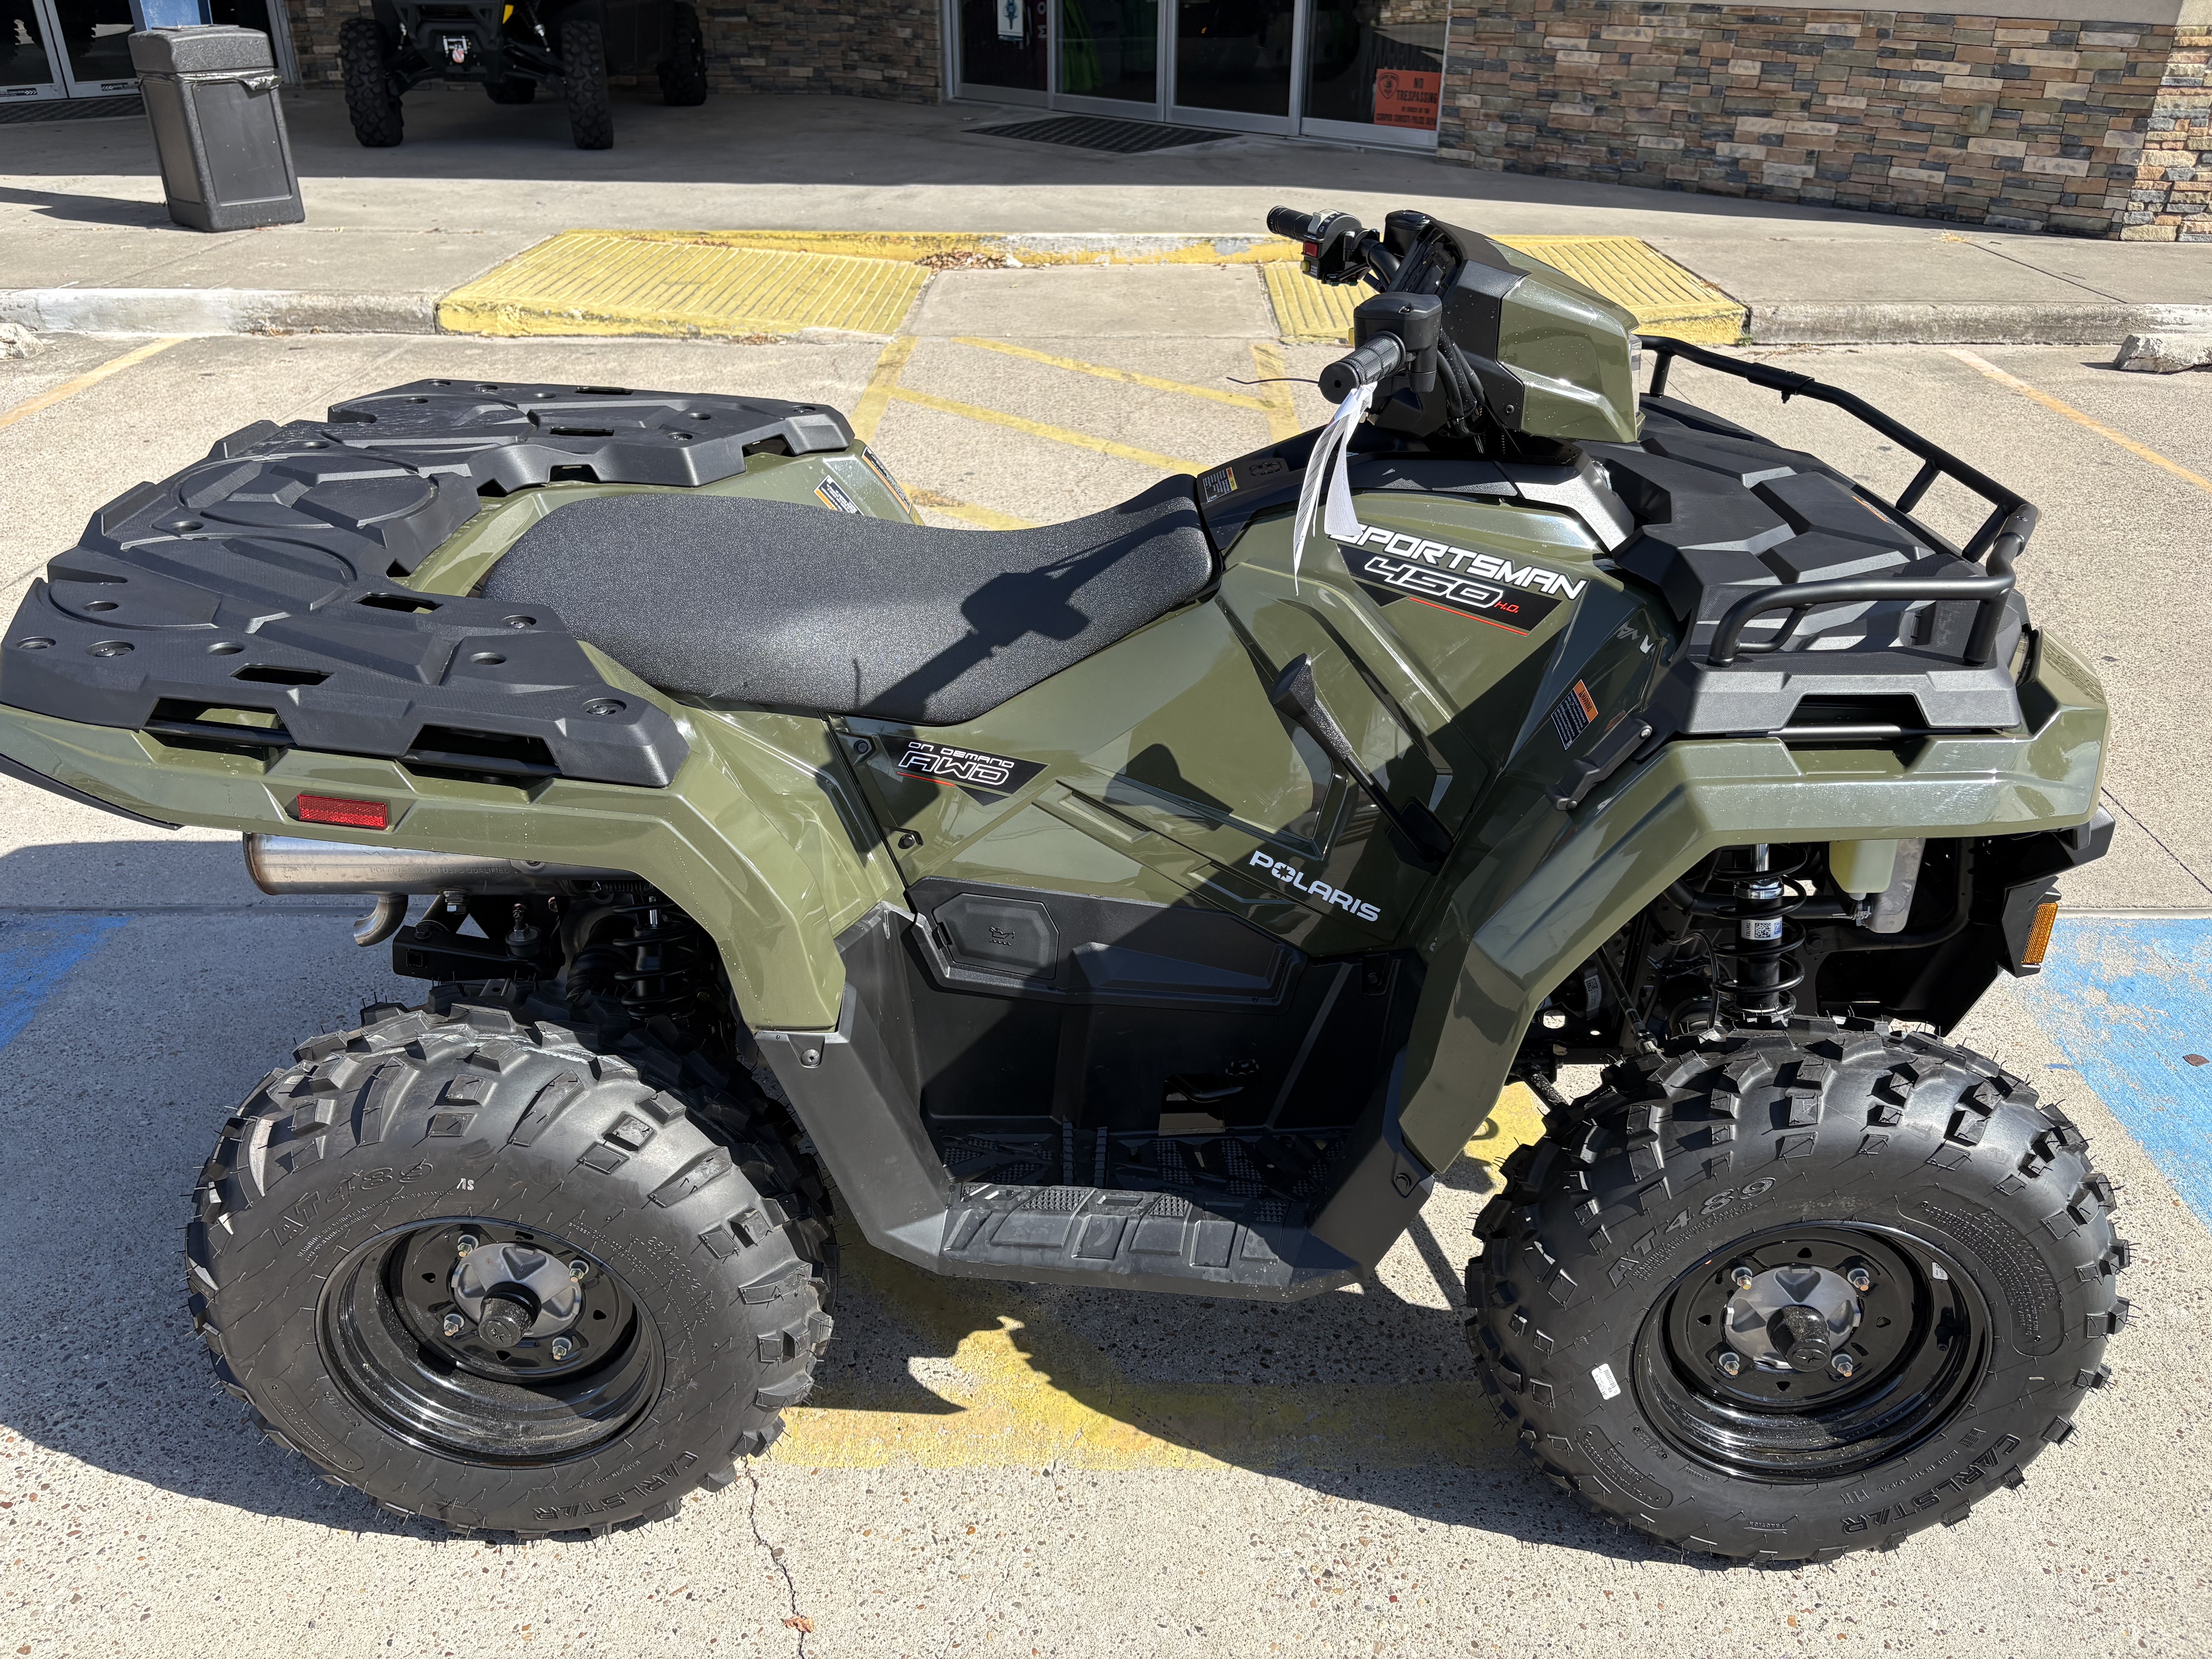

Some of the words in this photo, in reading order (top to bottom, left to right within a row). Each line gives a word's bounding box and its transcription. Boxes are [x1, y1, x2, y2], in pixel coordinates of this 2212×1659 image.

[1397, 90, 1437, 103] TRESPASSING
[1414, 78, 1424, 89] NO
[1364, 556, 1504, 609] 450
[1494, 600, 1520, 613] H.O.
[898, 750, 1010, 786] AWD
[908, 741, 934, 752] ON
[940, 747, 1015, 769] DEMAND
[1249, 850, 1381, 922] POLARIS
[2028, 1274, 2047, 1317] SERVICE
[1602, 1447, 1647, 1483] TUBELESS
[1840, 1433, 2021, 1534] CARLSTAR
[532, 1451, 698, 1521] CARLSTAR
